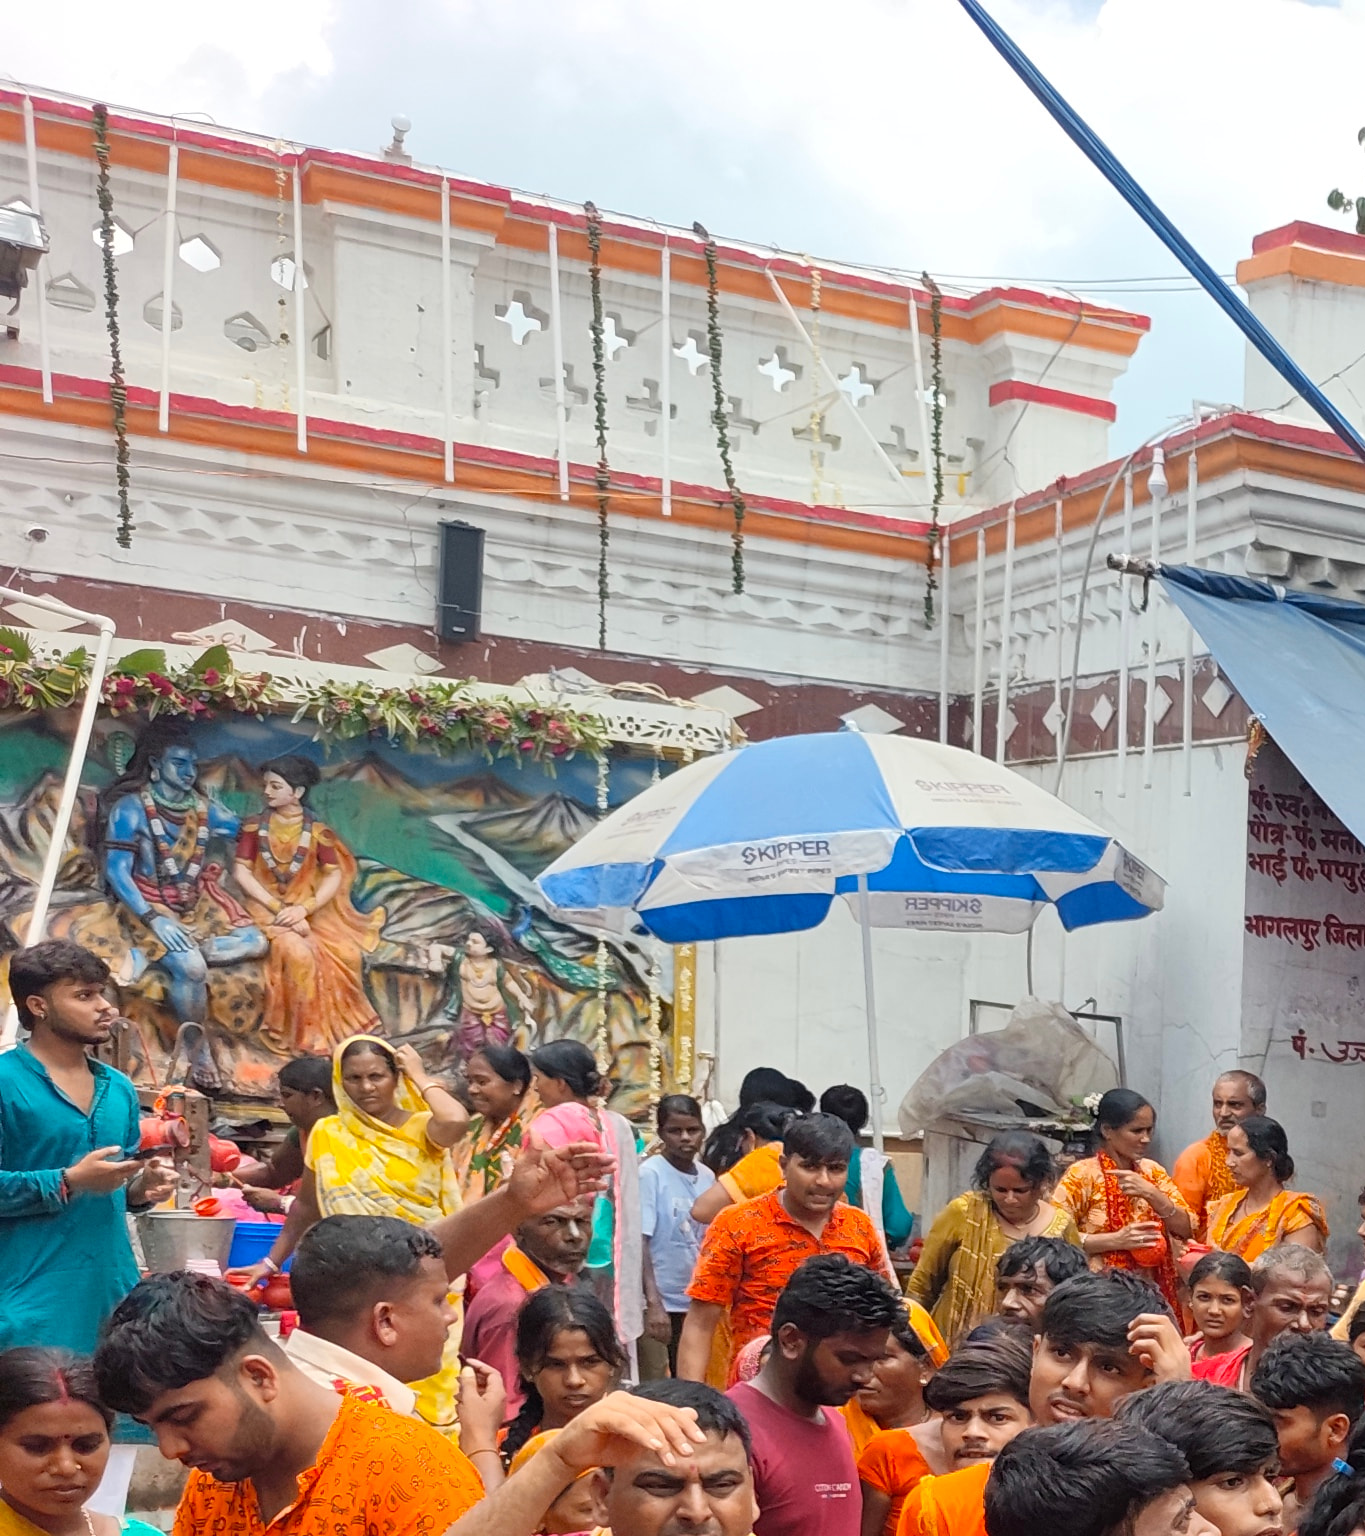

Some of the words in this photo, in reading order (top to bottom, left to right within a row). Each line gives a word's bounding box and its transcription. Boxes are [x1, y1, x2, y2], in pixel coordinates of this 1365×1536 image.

[915, 779, 1012, 795] SKIPPER
[741, 840, 831, 865] SKIPPER
[1245, 914, 1321, 951] भागलपुर
